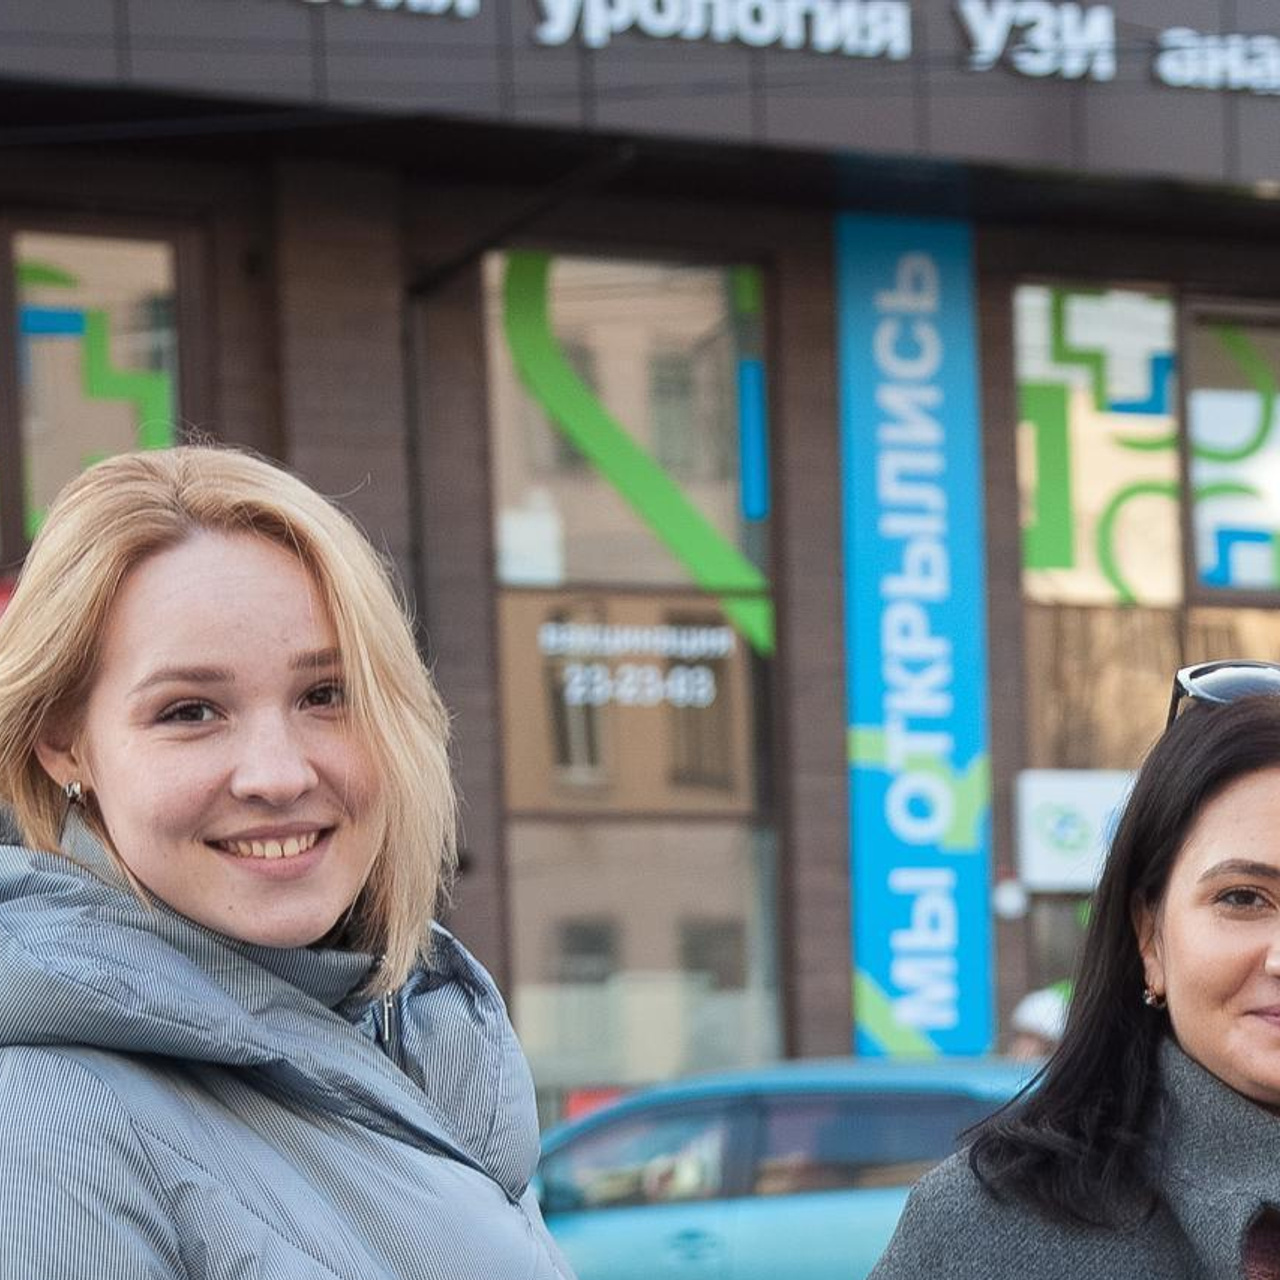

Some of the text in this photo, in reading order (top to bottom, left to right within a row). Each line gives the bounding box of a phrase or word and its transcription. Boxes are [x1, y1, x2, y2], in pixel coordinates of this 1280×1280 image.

[536, 0, 912, 60] урология
[957, 0, 1117, 82] УЗИ
[871, 249, 959, 1029] МЫ ОТКРЫЛИСЬ
